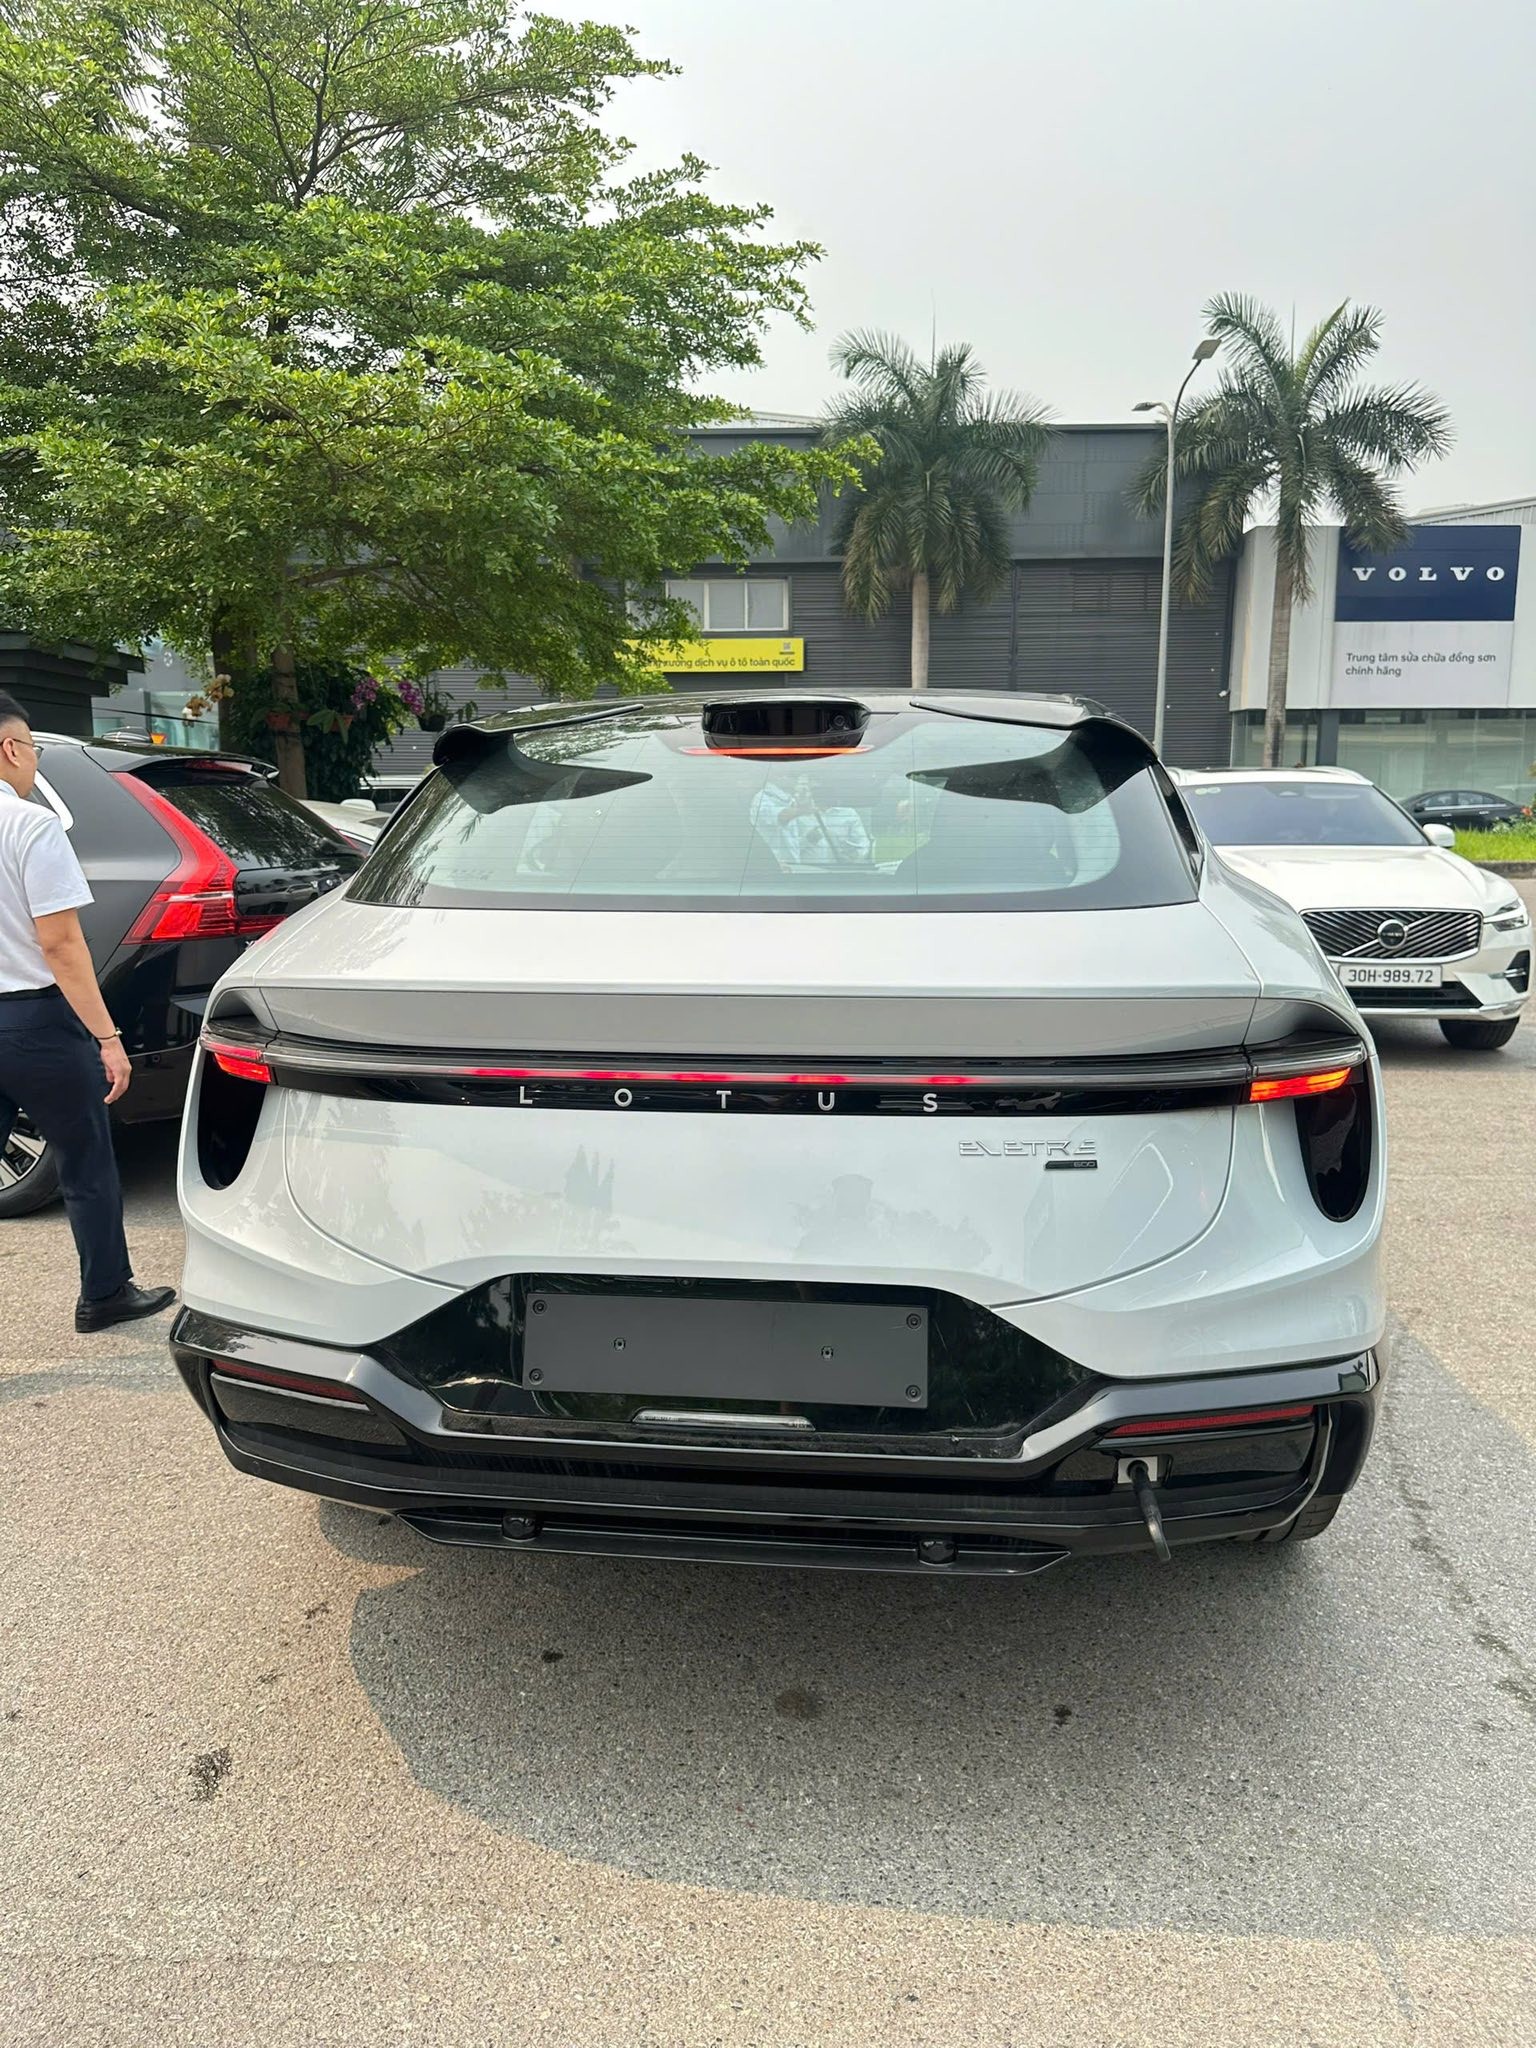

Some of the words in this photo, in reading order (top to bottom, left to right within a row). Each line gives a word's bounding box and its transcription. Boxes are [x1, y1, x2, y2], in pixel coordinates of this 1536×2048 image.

[1352, 566, 1505, 581] VOLVO
[716, 659, 728, 668] vụ
[1346, 653, 1376, 663] Trung
[1378, 652, 1398, 662] tâm
[1401, 651, 1419, 662] sửa
[1421, 652, 1446, 662] chữa
[1448, 651, 1475, 664] đồng
[1477, 654, 1496, 662] sơn
[1345, 666, 1374, 676] chính
[1376, 666, 1402, 677] hãng
[1348, 969, 1433, 983] 30H-989.72
[519, 1086, 938, 1113] LOTUS
[959, 1140, 1097, 1156] ELETRE
